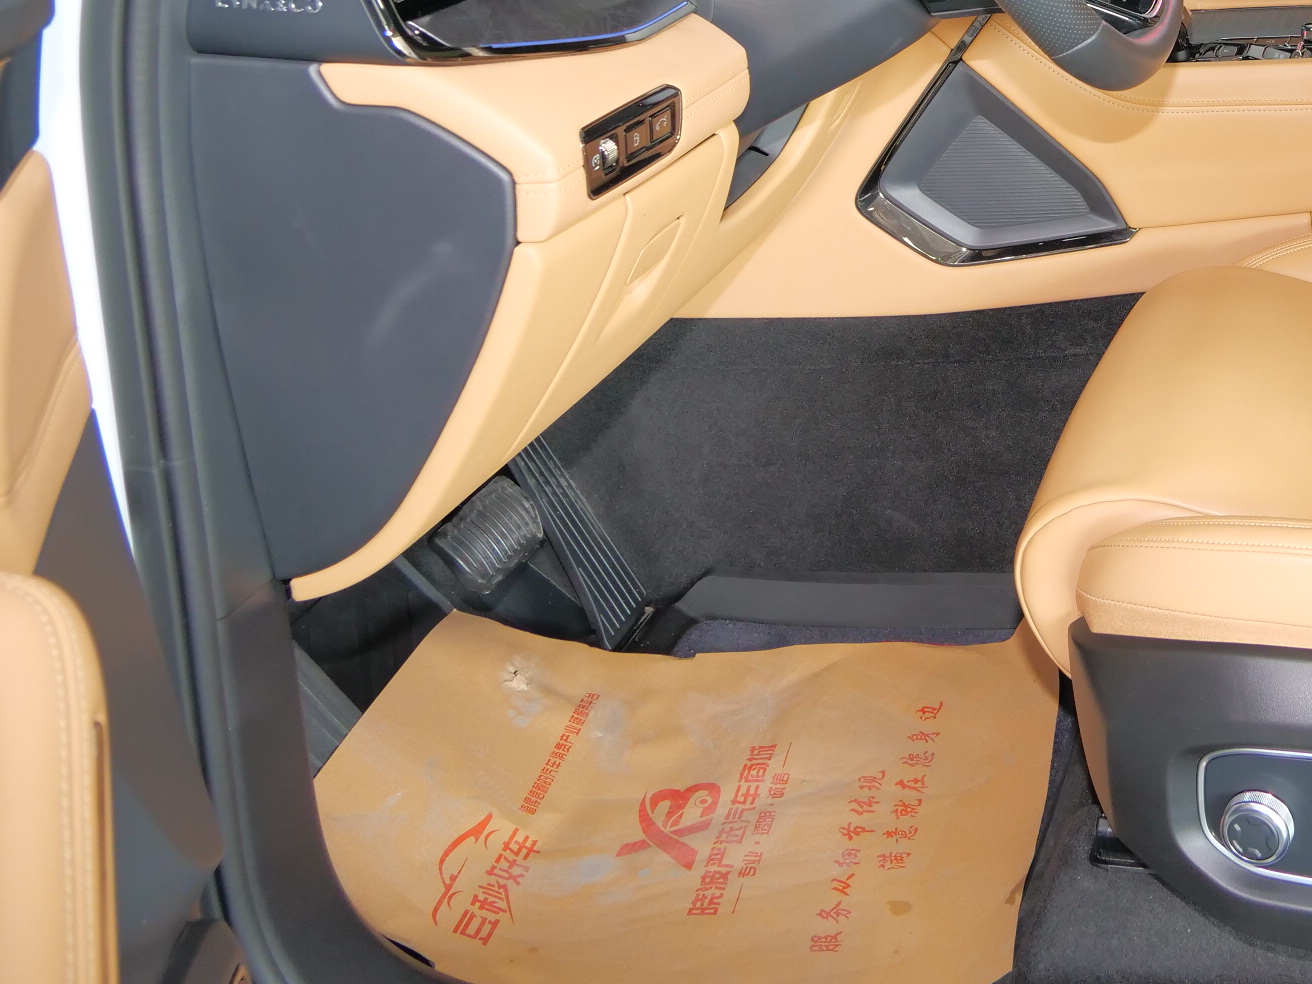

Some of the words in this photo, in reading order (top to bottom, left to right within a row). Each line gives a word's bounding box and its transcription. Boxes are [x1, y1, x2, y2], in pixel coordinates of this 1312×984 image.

[687, 743, 778, 917] 晓波严选汽车商城
[811, 770, 887, 953] 服务从细节体现
[878, 702, 945, 869] 满意就在您身边
